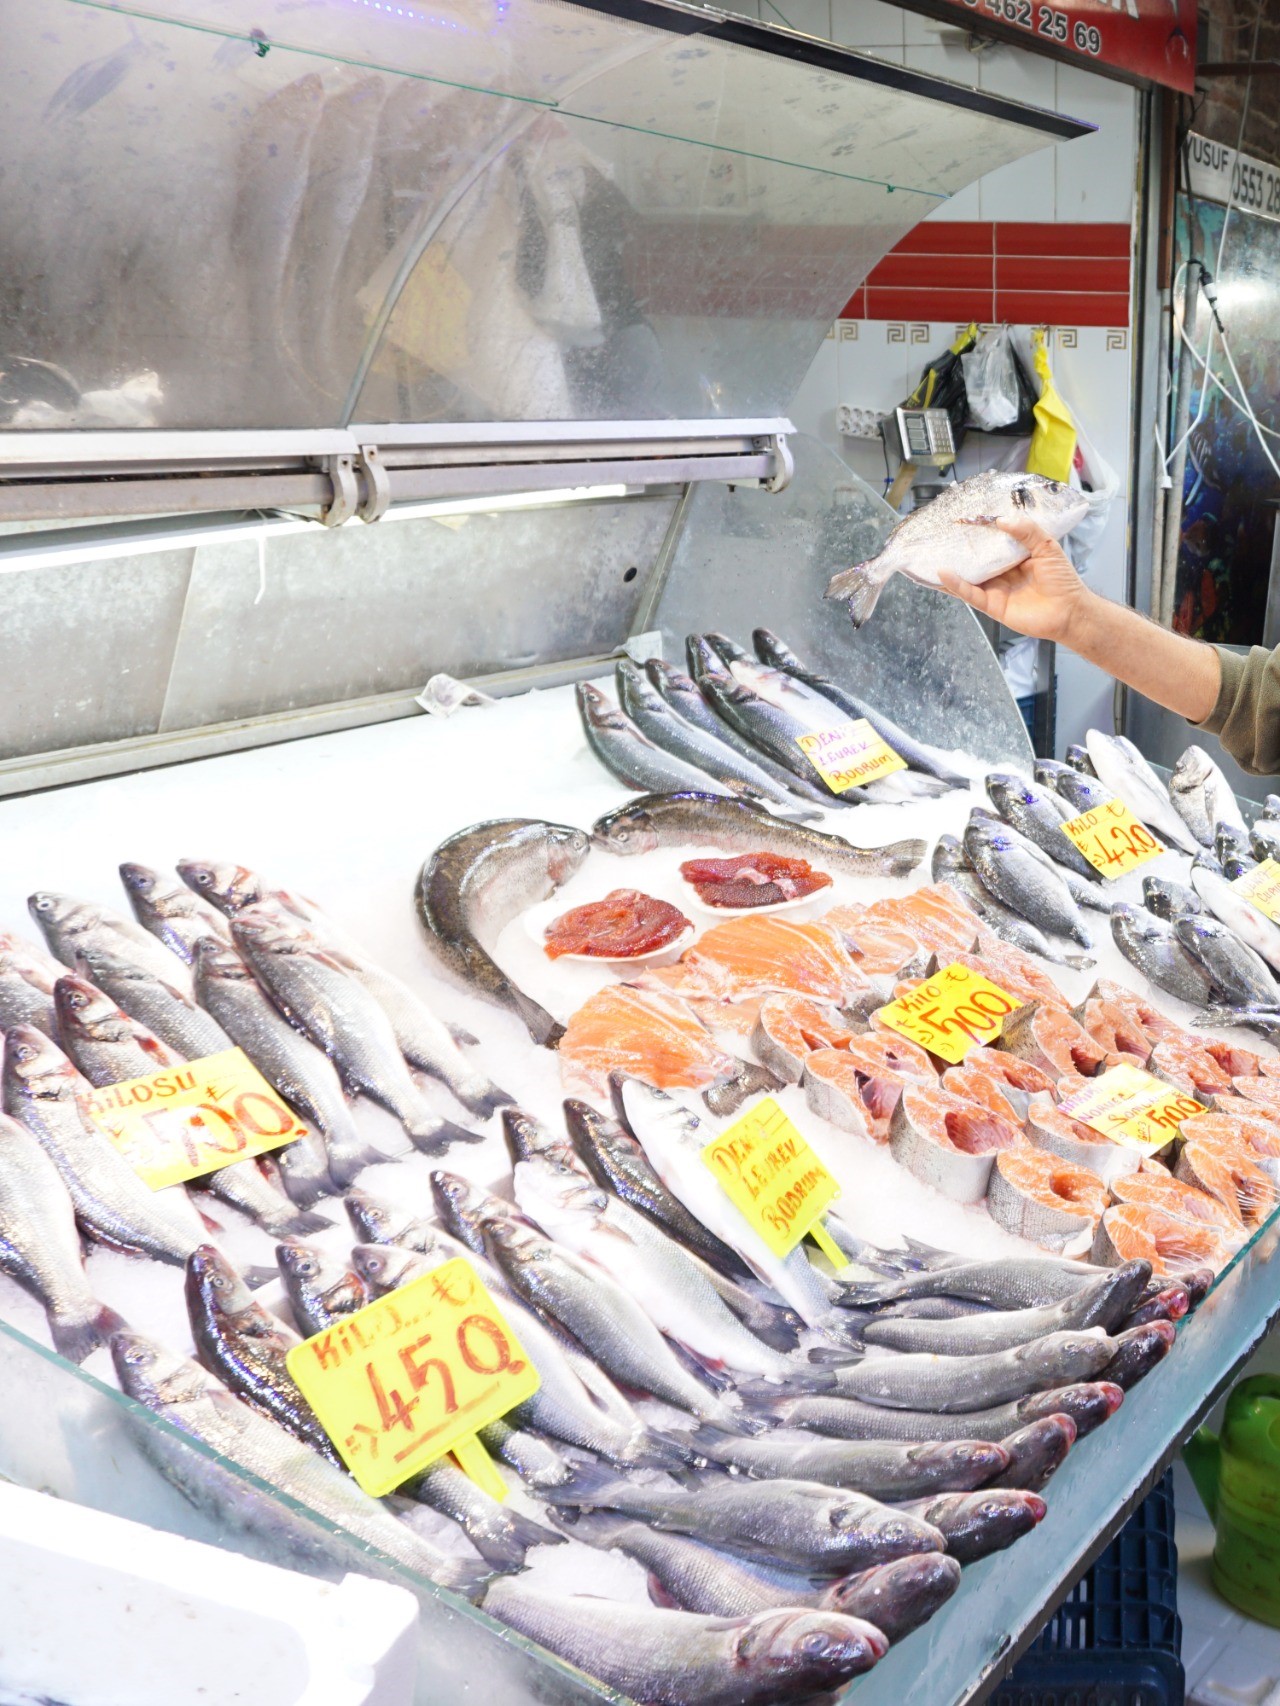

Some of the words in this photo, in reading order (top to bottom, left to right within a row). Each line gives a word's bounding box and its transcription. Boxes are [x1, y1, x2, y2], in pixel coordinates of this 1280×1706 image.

[1038, 6, 1068, 42] 25
[1074, 21, 1101, 55] 69
[1231, 161, 1264, 208] 0553
[828, 753, 895, 787] BODRUM
[761, 1166, 828, 1239] BODRUM
